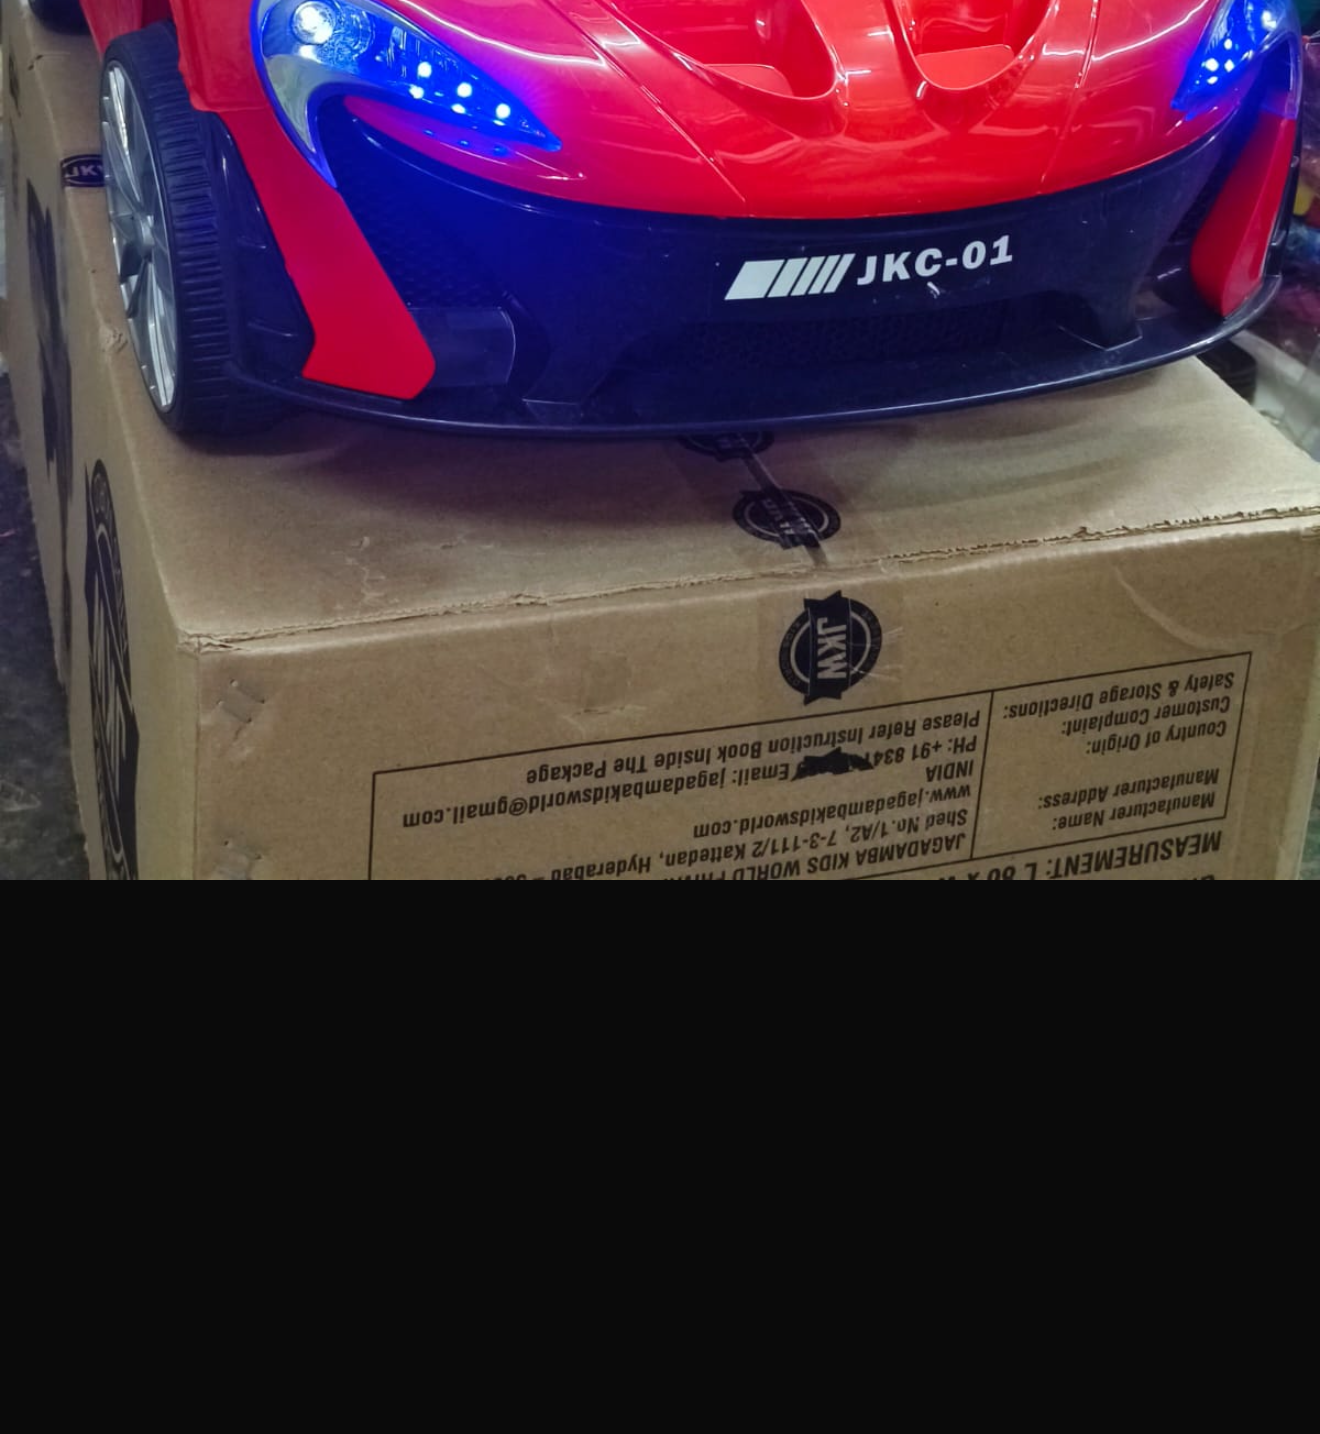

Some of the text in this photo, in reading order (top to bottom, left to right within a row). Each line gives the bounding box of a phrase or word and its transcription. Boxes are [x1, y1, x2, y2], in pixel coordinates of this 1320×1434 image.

[856, 234, 1013, 286] JKC-01
[816, 616, 848, 680] JKW
[1003, 672, 1234, 719] Safety & Storage Directions:
[1062, 696, 1230, 736] Customer Complaint:
[526, 710, 980, 786] Please Refer Instruction Book Inside The Package
[912, 740, 943, 761] +91
[947, 735, 978, 756] PH:
[1086, 720, 1227, 755] Country of Origin:
[732, 763, 790, 786] Email:
[925, 760, 974, 782] INDIA
[402, 768, 726, 829] jagadambakidsworld@gmail.com
[1038, 768, 1219, 810] Manufacturer Address:
[693, 784, 970, 839] www.jagadambakidsworld.com
[926, 808, 968, 830] Shed
[1052, 792, 1216, 831] Manufacturer Name:
[659, 843, 746, 869] Kattedan,
[752, 830, 837, 859] 7-3-111/2
[856, 833, 966, 865] JAGADAMBA
[1046, 830, 1222, 878] MEASUREMENT:
[551, 854, 651, 880] Hyderabad
[733, 856, 802, 880] WORLD
[806, 852, 849, 874] KIDS
[1024, 862, 1038, 880] L
